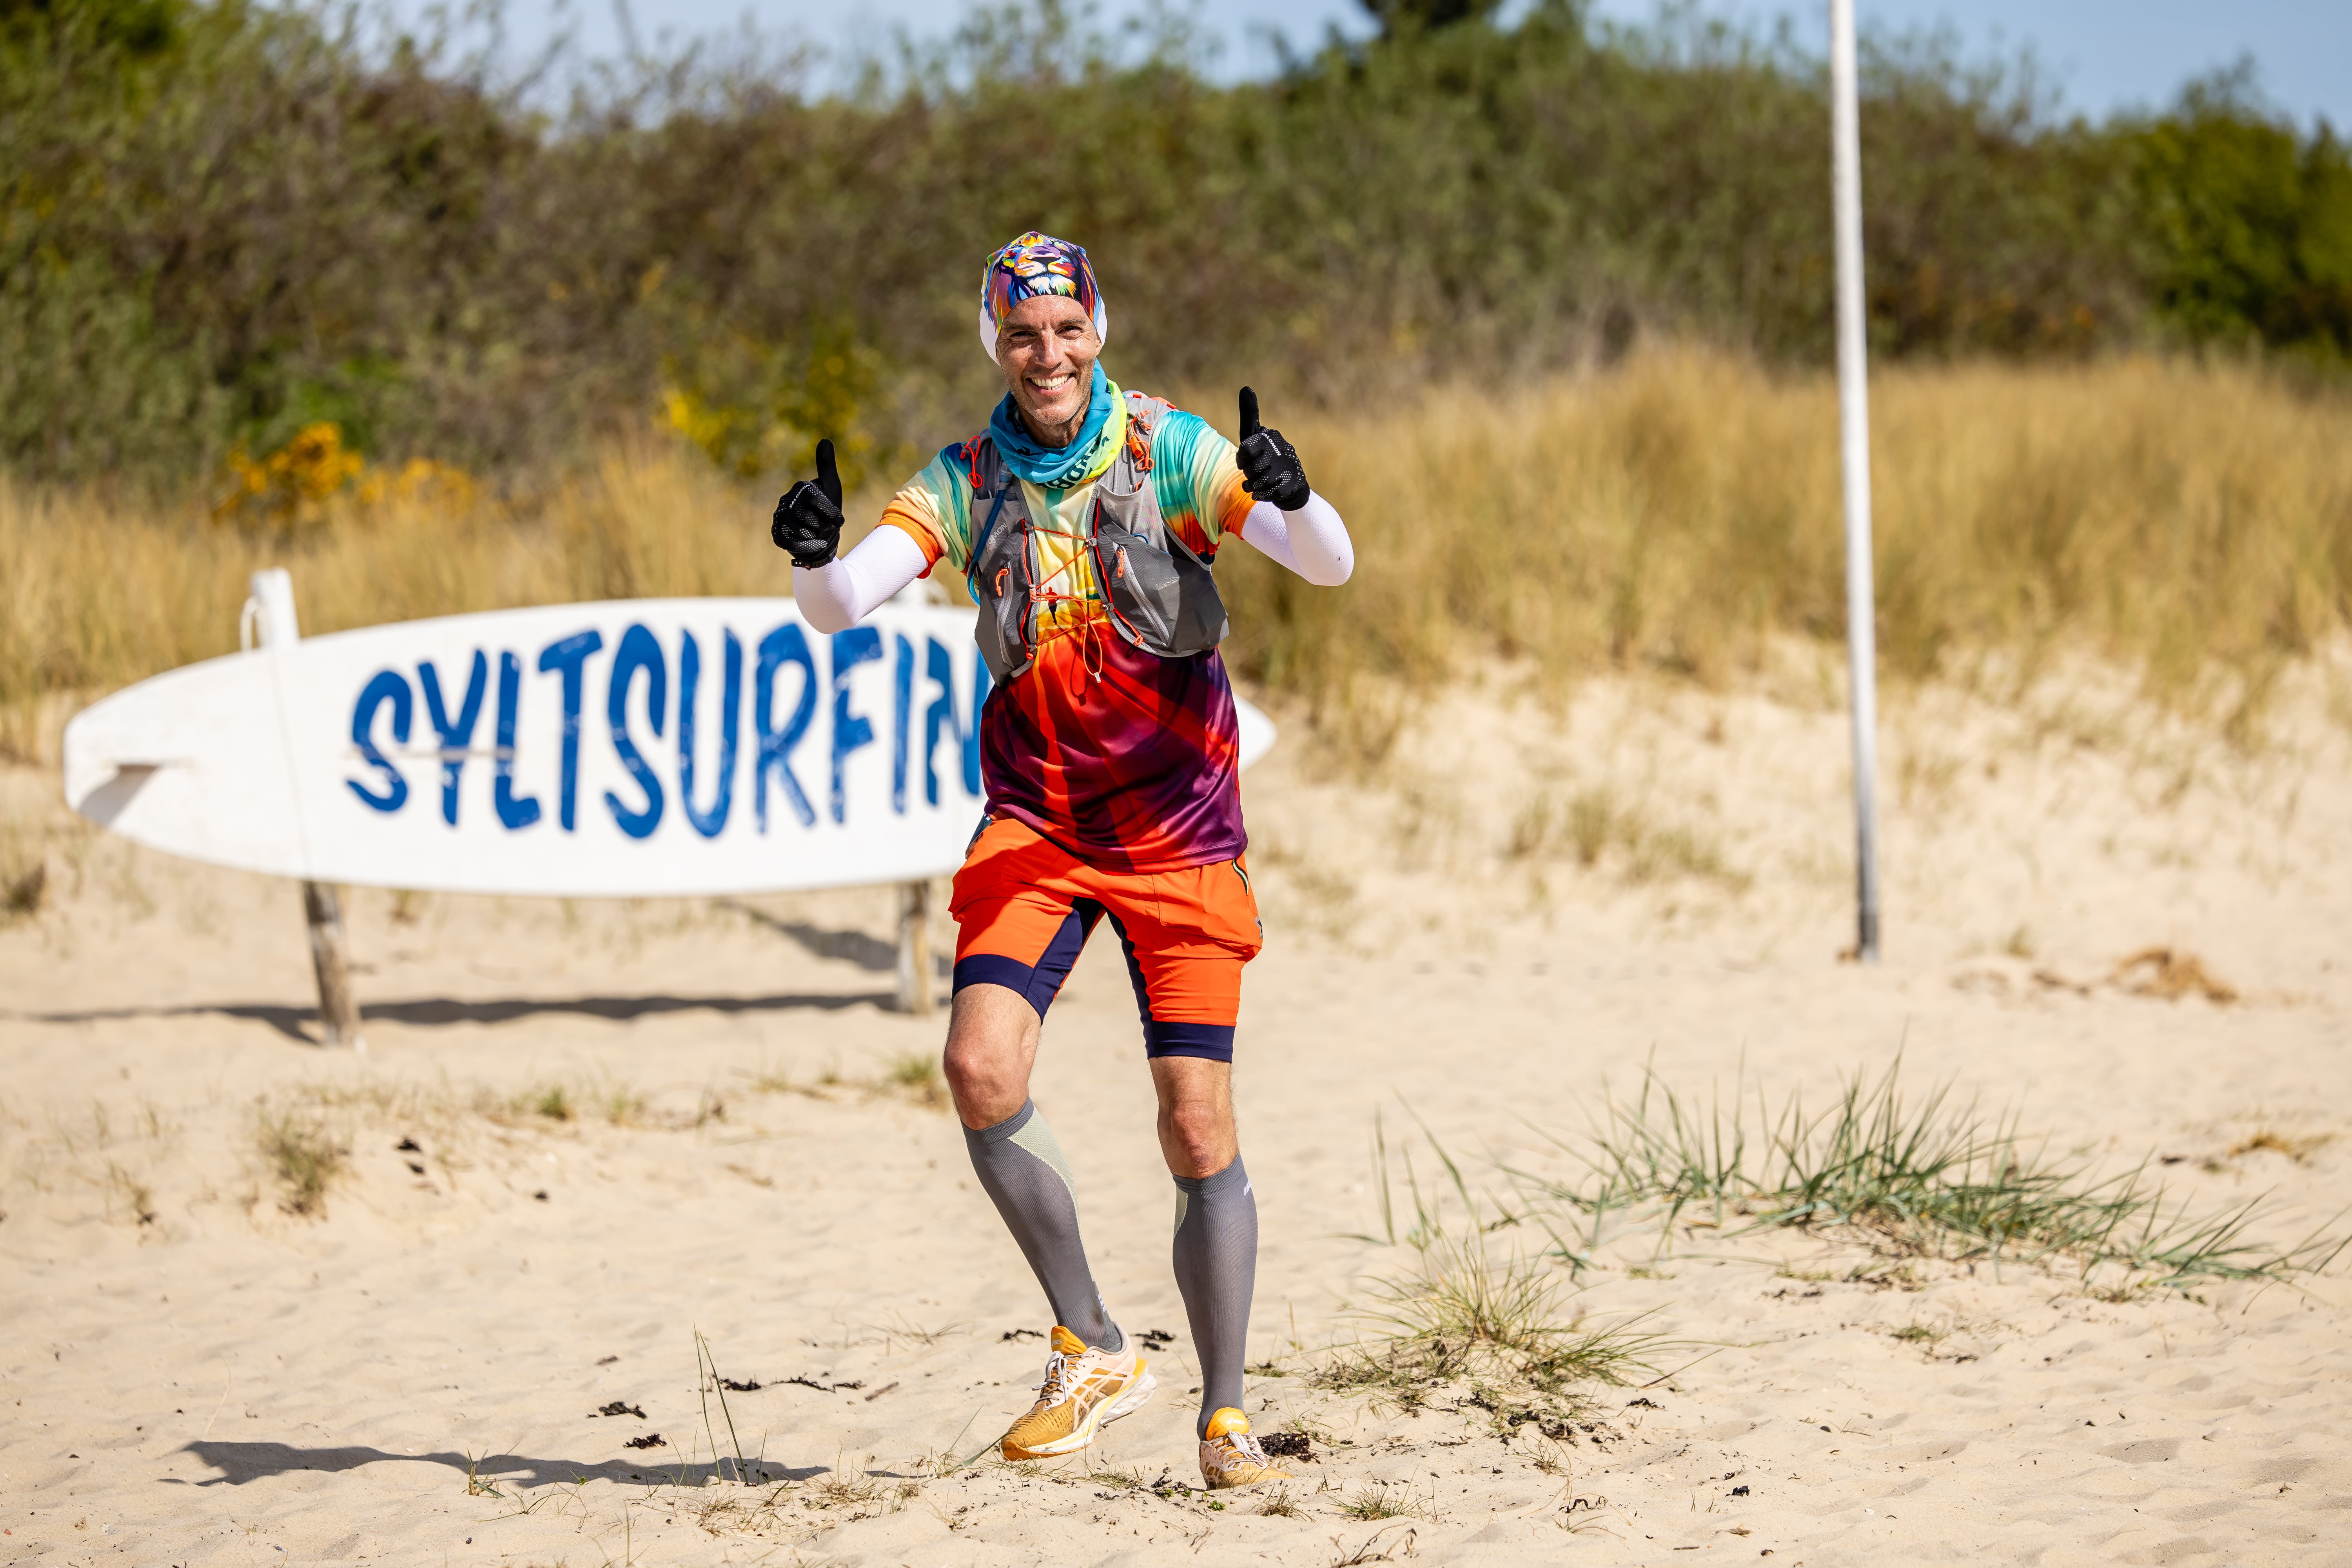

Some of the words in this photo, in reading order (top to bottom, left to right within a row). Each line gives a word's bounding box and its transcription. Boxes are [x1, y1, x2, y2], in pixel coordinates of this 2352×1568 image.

[1260, 433, 1281, 456] SALOMON
[789, 485, 810, 509] SALOMON
[988, 522, 1007, 544] OMON
